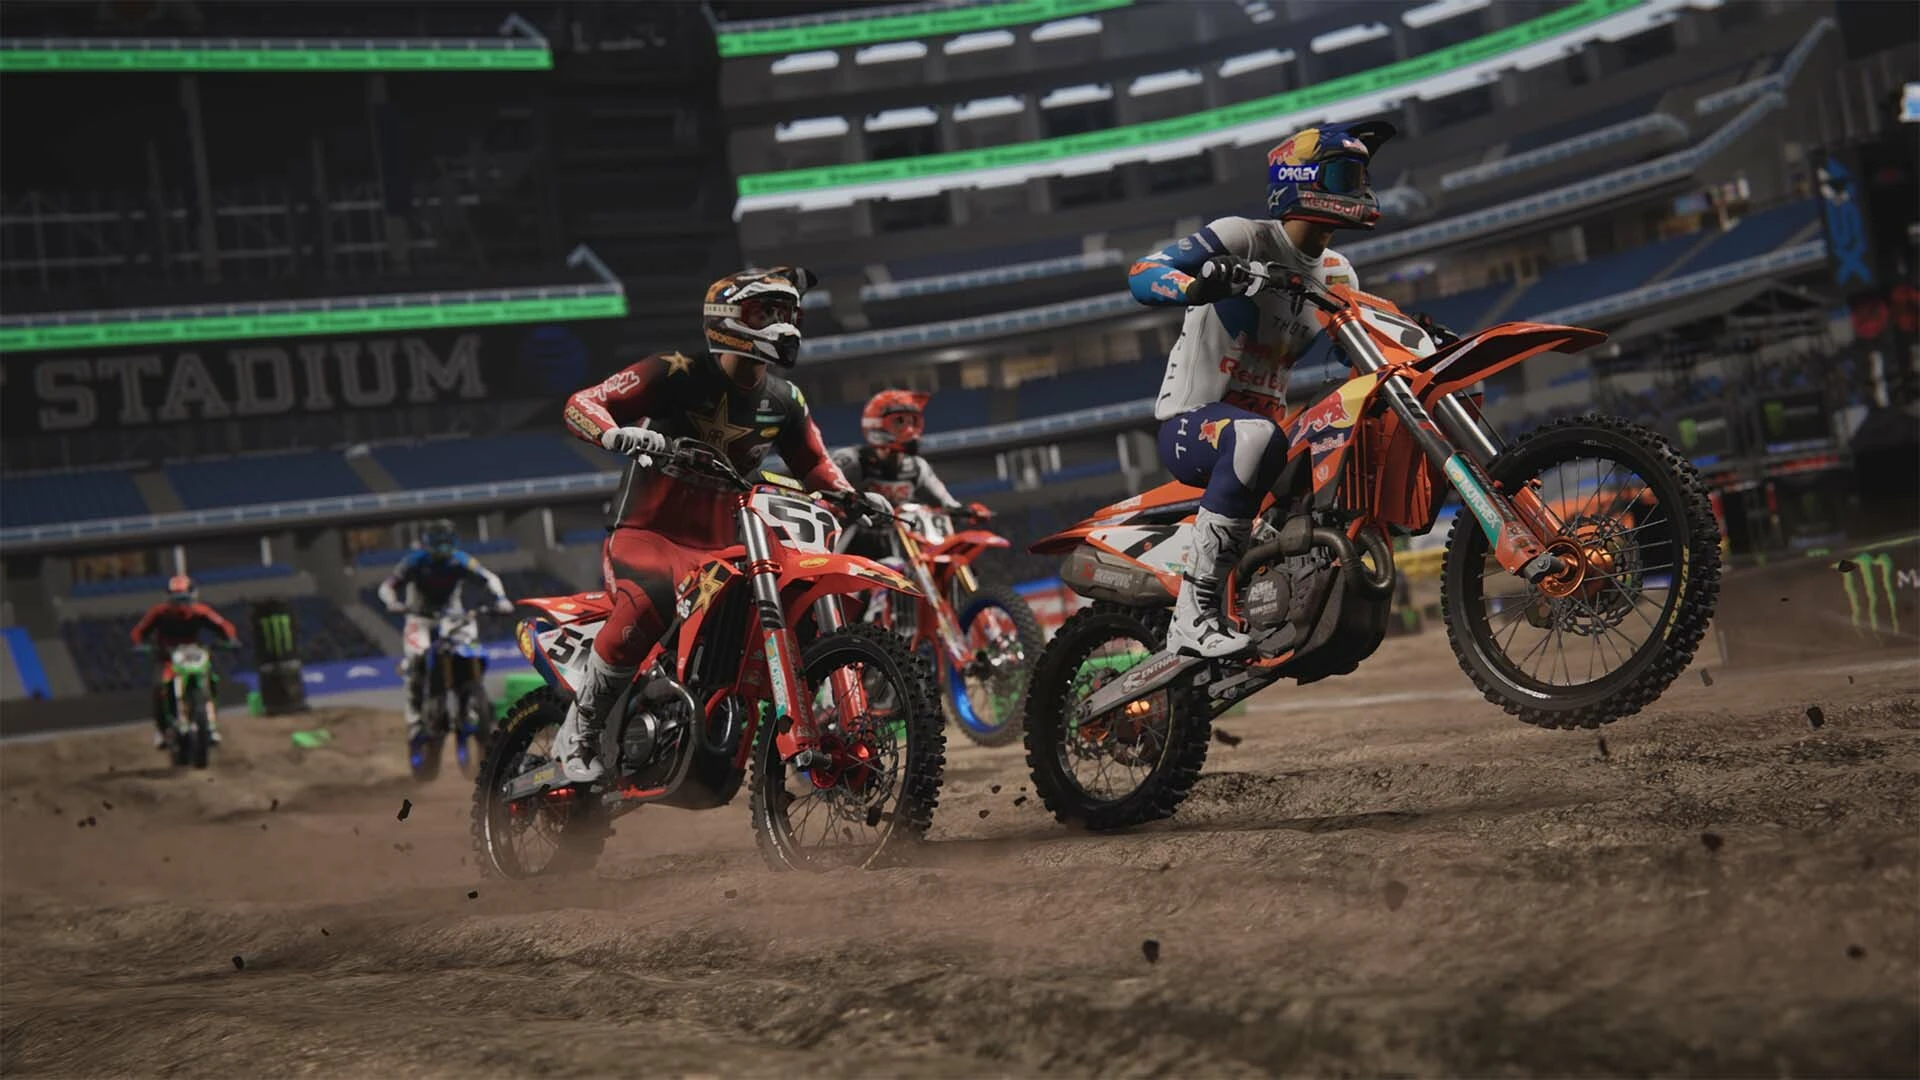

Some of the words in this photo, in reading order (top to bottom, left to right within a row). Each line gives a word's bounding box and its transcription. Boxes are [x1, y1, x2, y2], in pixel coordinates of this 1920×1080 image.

[1278, 166, 1320, 182] OAKLEY
[34, 334, 488, 431] STADIUM
[1460, 477, 1500, 529] MOTOREX
